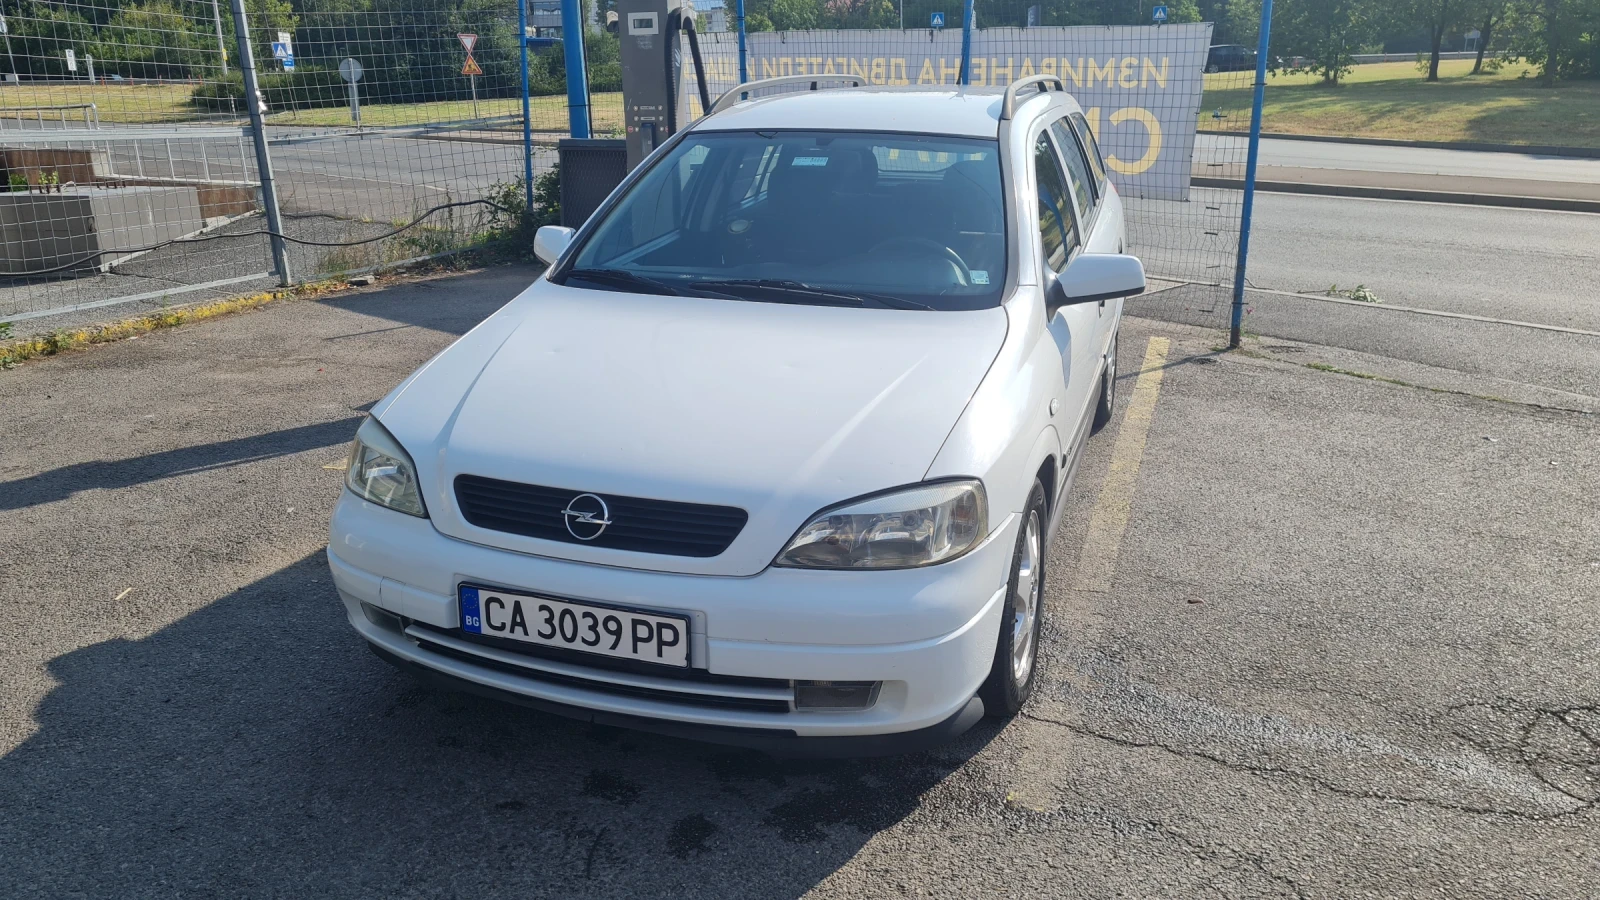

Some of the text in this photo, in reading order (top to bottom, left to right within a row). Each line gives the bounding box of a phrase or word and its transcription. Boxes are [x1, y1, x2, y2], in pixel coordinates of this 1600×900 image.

[465, 615, 480, 627] BG
[484, 596, 680, 658] CA 3039 PP
